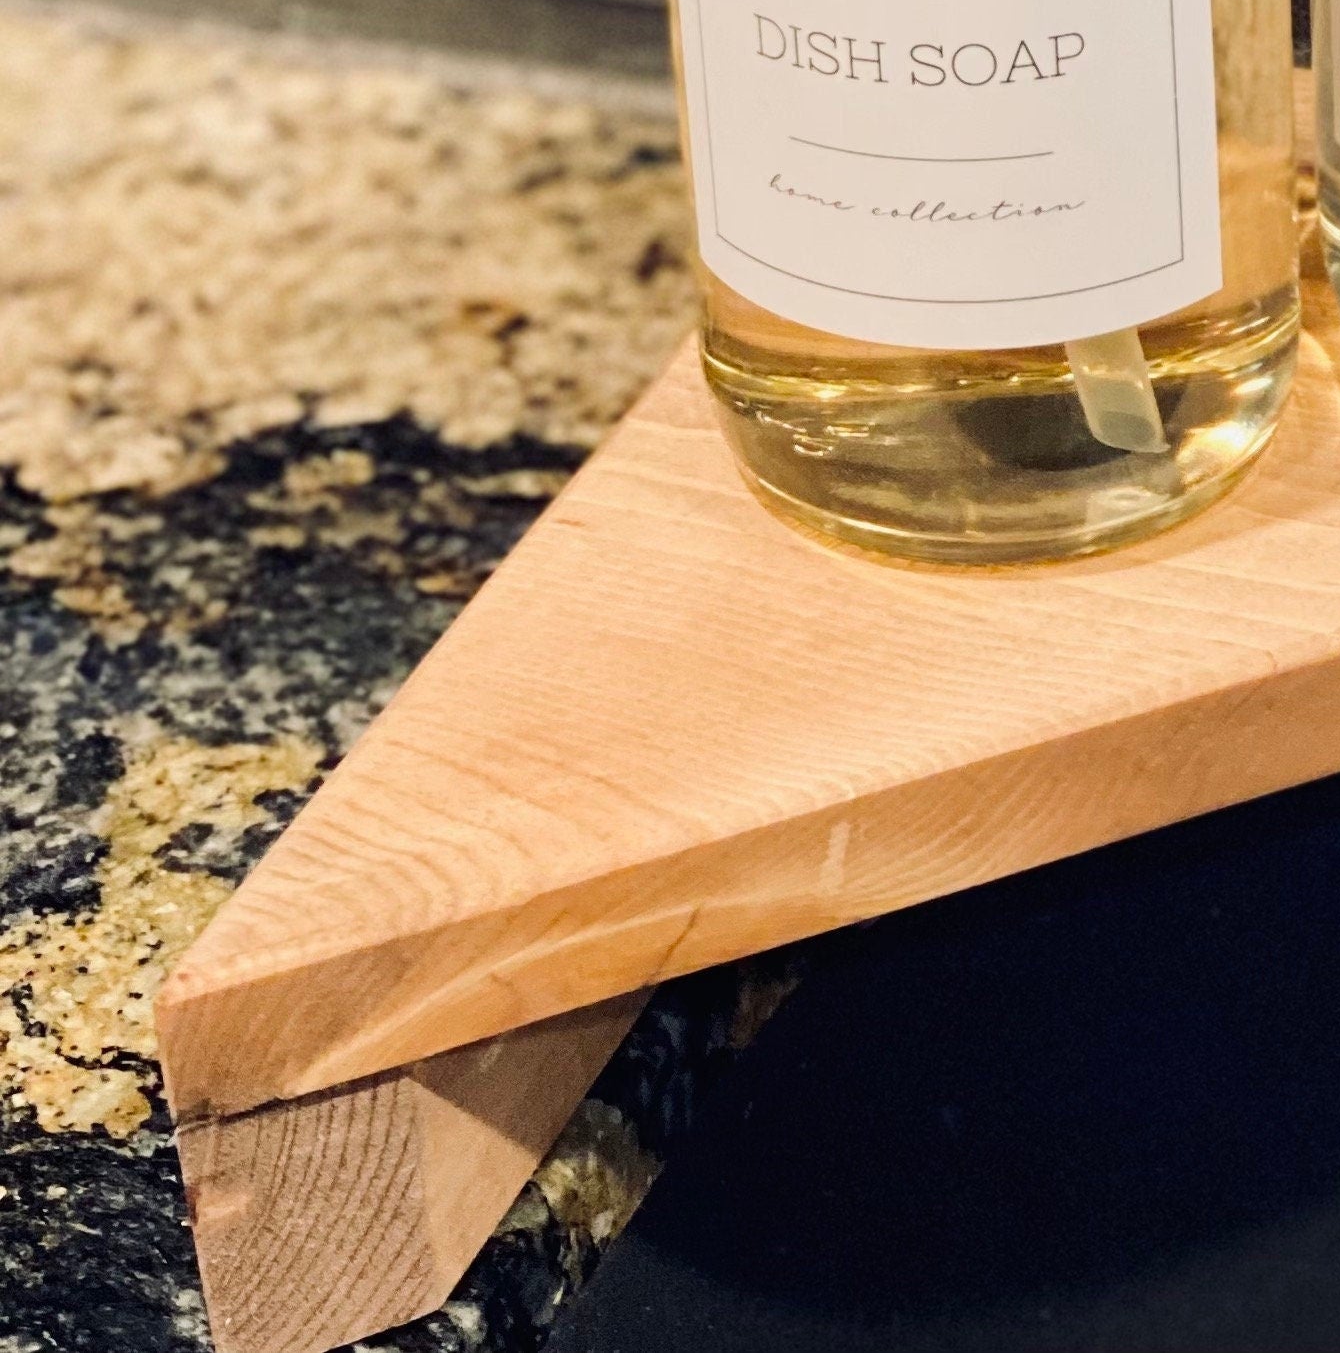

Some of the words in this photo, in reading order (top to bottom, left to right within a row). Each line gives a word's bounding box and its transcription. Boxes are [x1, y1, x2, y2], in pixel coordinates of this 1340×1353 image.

[753, 13, 890, 84] DISH
[909, 32, 1086, 88] SOAP
[769, 174, 856, 211] home
[871, 199, 1086, 223] collection
